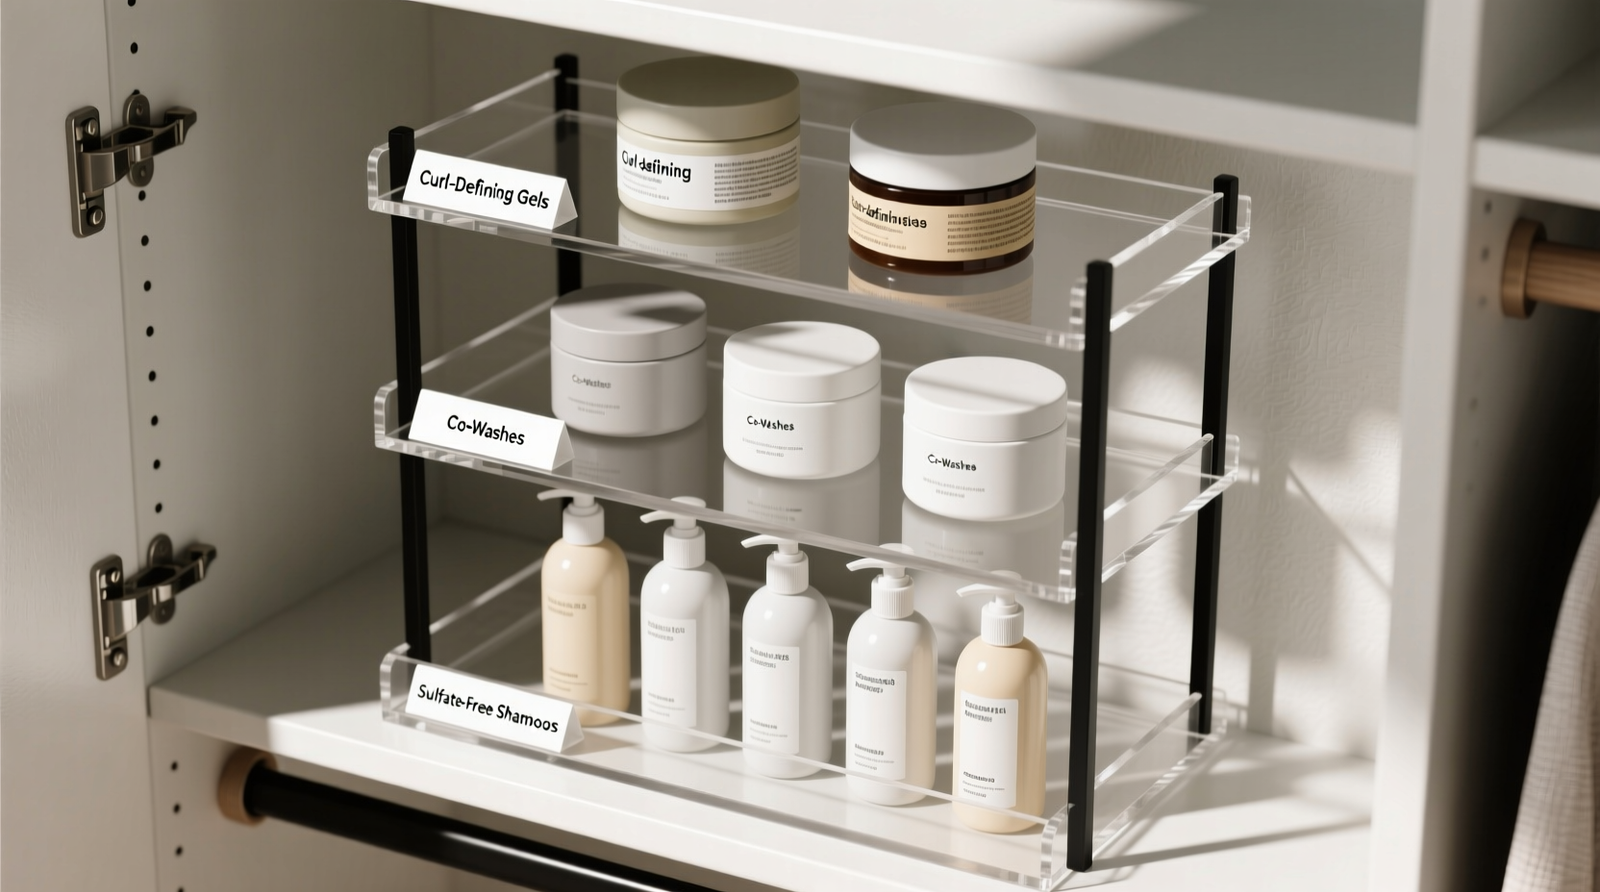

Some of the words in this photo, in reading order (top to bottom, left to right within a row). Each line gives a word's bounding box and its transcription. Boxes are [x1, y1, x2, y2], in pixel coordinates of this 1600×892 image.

[419, 169, 514, 206] Curl-Defining
[517, 189, 550, 209] Gels
[447, 414, 526, 445] Co-Washes
[417, 684, 494, 716] Sulfate-Free
